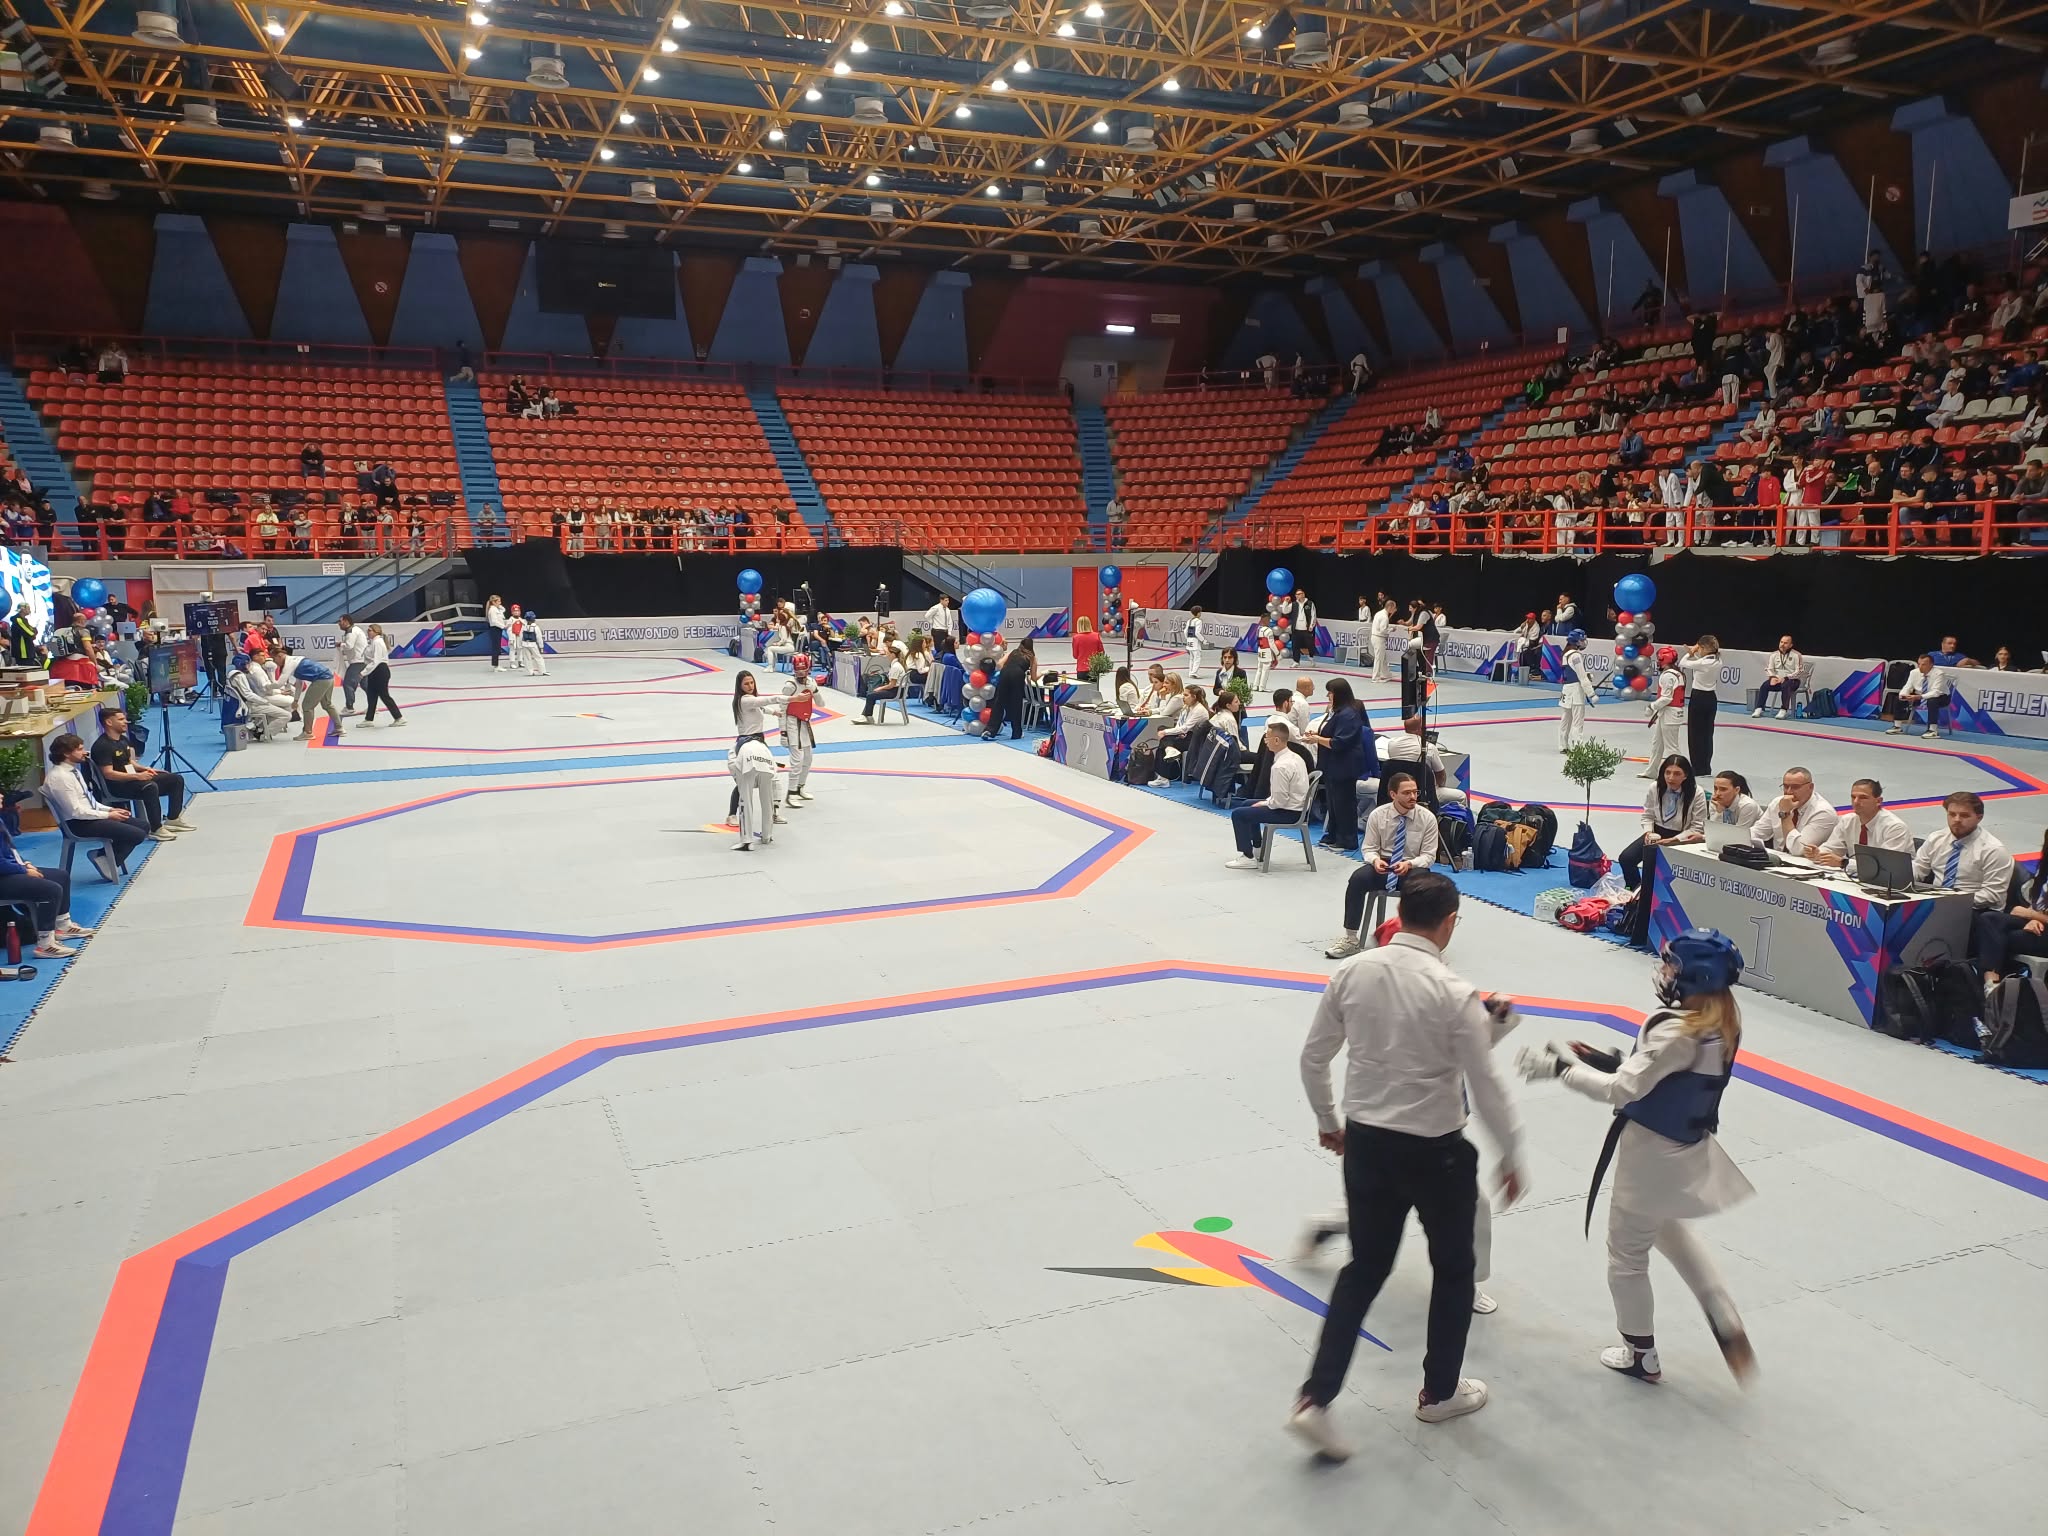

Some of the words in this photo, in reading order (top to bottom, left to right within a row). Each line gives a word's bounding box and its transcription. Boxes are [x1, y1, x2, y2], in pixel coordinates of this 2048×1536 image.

[1005, 618, 1014, 629] IS
[1018, 617, 1038, 629] YOU
[601, 626, 679, 640] TAEKWONDO
[684, 625, 739, 638] FEDERATI
[1215, 624, 1240, 638] DREAM
[312, 636, 336, 649] WE
[1720, 666, 1741, 684] OU
[1671, 864, 1716, 888] HELLENIC
[1719, 877, 1787, 908] TAEKWONDO
[1790, 897, 1862, 929] FEDERATION
[1745, 915, 1775, 983] 1
